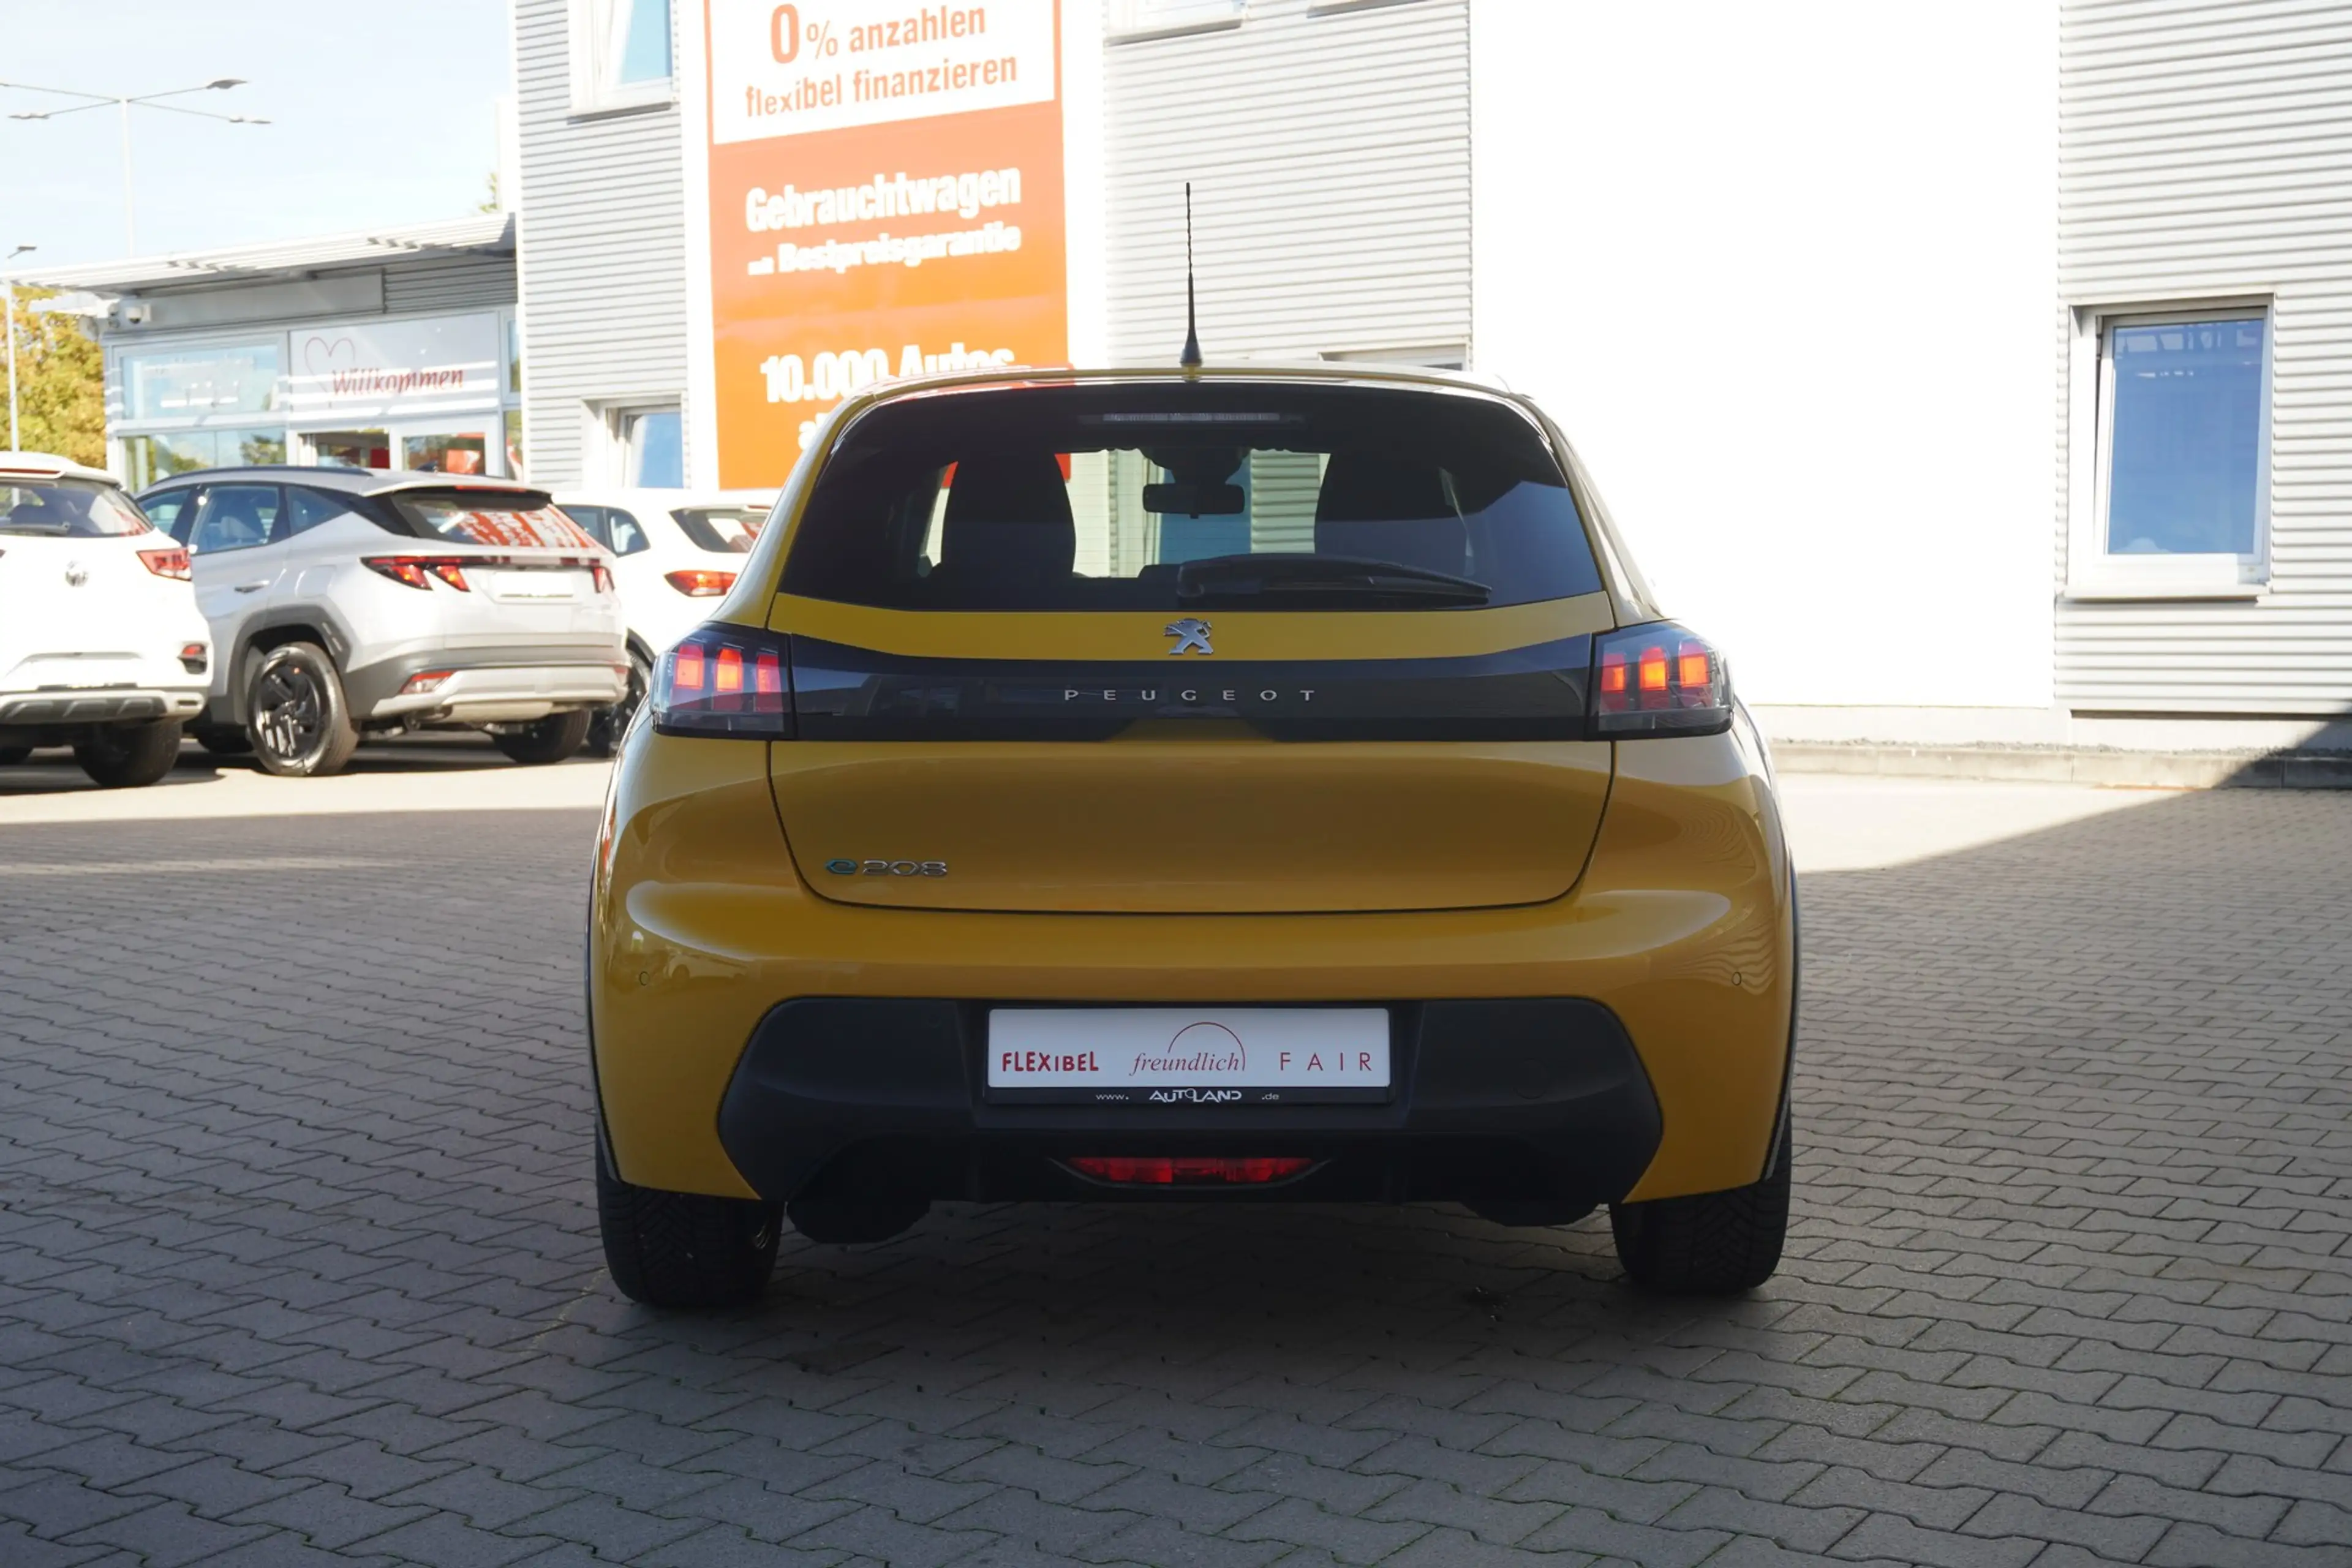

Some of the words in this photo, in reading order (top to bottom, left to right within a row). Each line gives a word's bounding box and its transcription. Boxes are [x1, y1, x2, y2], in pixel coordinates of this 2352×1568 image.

[849, 6, 986, 53] anzahlen
[745, 74, 842, 118] flexibel
[853, 55, 1017, 103] finanzieren
[745, 167, 1021, 232] Gebrauchtwagen
[778, 221, 1021, 273] Bestpreisgarantie
[331, 368, 464, 396] Willkommen
[760, 349, 889, 402] 10.000
[1065, 690, 1316, 702] PEUGEOT
[1001, 1050, 1099, 1072] FLEXIBEL
[1129, 1052, 1241, 1076] freundlich
[1280, 1052, 1372, 1071] FAIR
[1149, 1088, 1242, 1102] AUTOLAND
